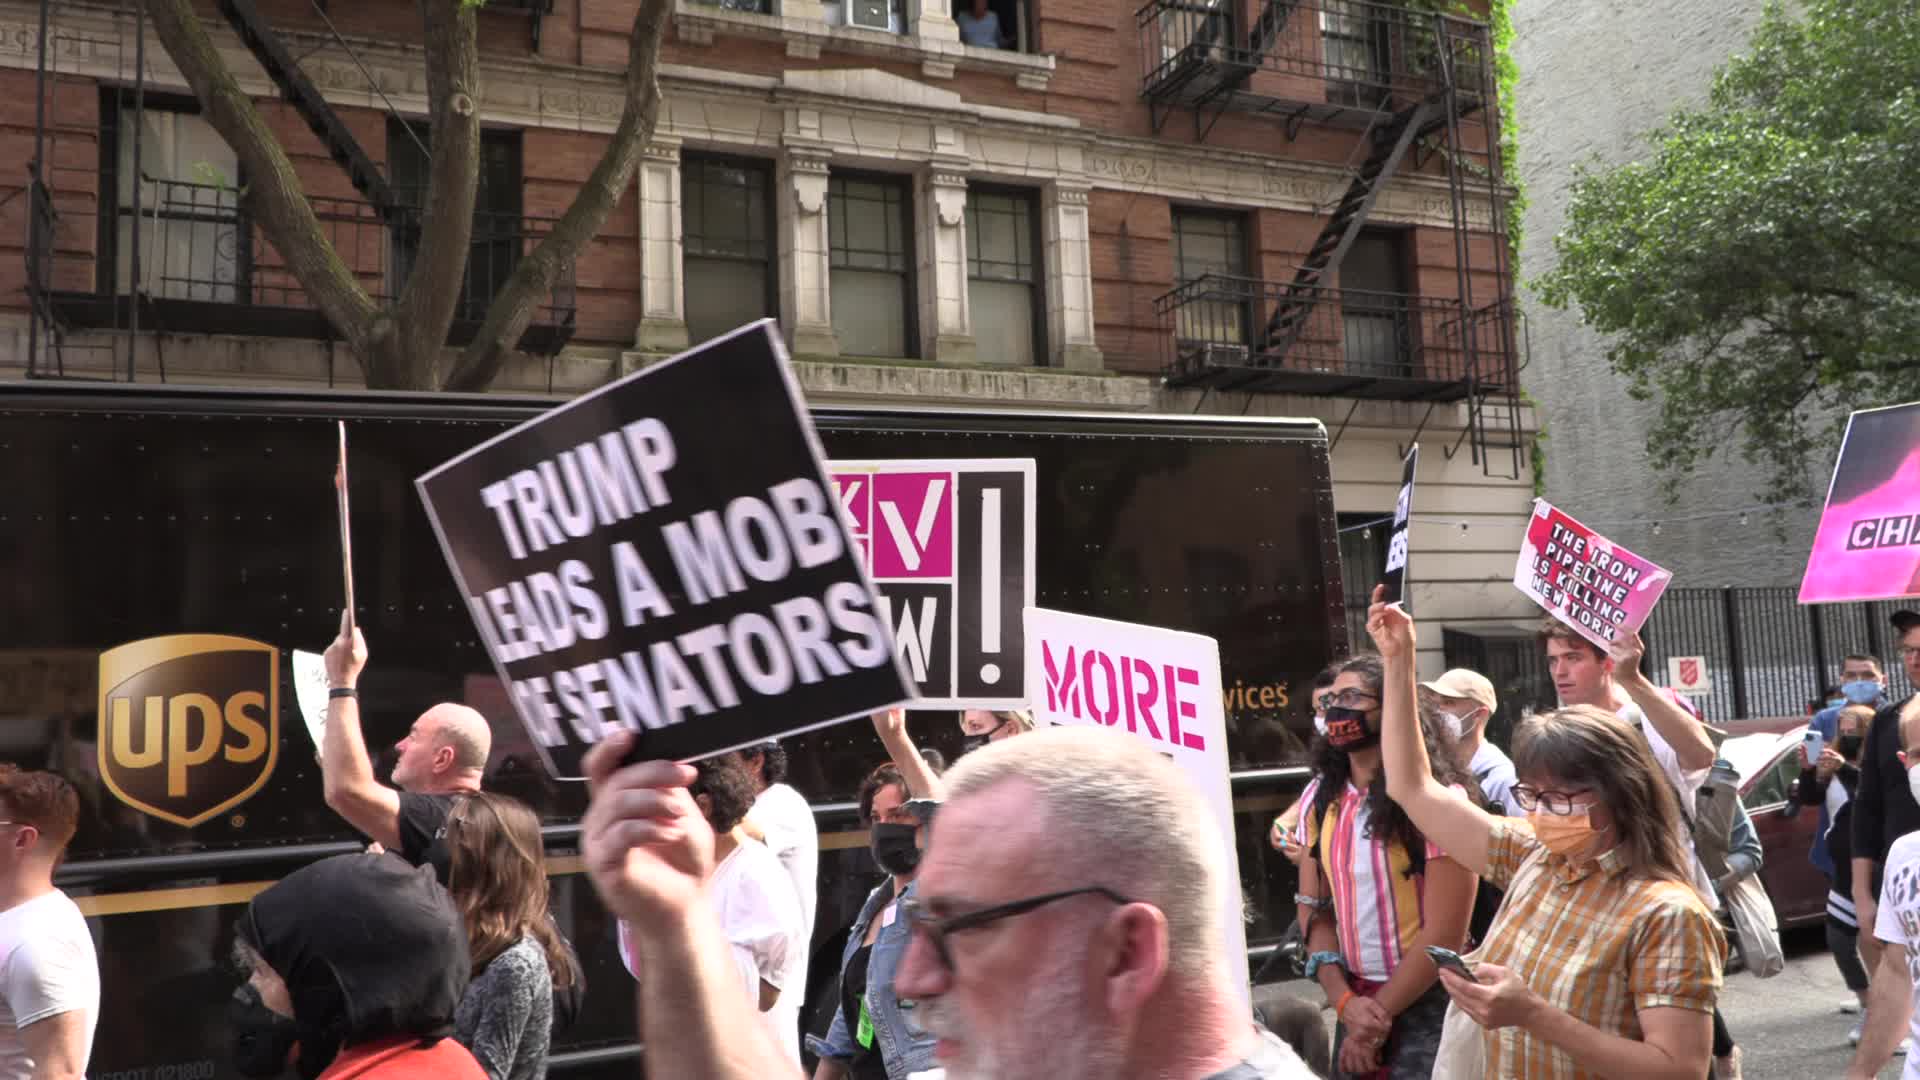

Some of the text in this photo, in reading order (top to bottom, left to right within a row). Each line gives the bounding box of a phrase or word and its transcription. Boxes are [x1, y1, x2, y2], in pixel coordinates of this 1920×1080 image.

[480, 418, 676, 559] TRUMP
[1553, 523, 1639, 586] THE IRON
[1852, 517, 1920, 547] CH
[471, 559, 609, 663] LEADS
[611, 541, 674, 627] A
[661, 477, 843, 605] MOB
[1534, 555, 1625, 624] IS KILLING
[1546, 543, 1627, 603] PIPELINE
[1532, 575, 1614, 640] NEW YORK
[553, 580, 891, 744] SENATORS
[1042, 640, 1205, 751] MORE
[1223, 680, 1289, 709] vices
